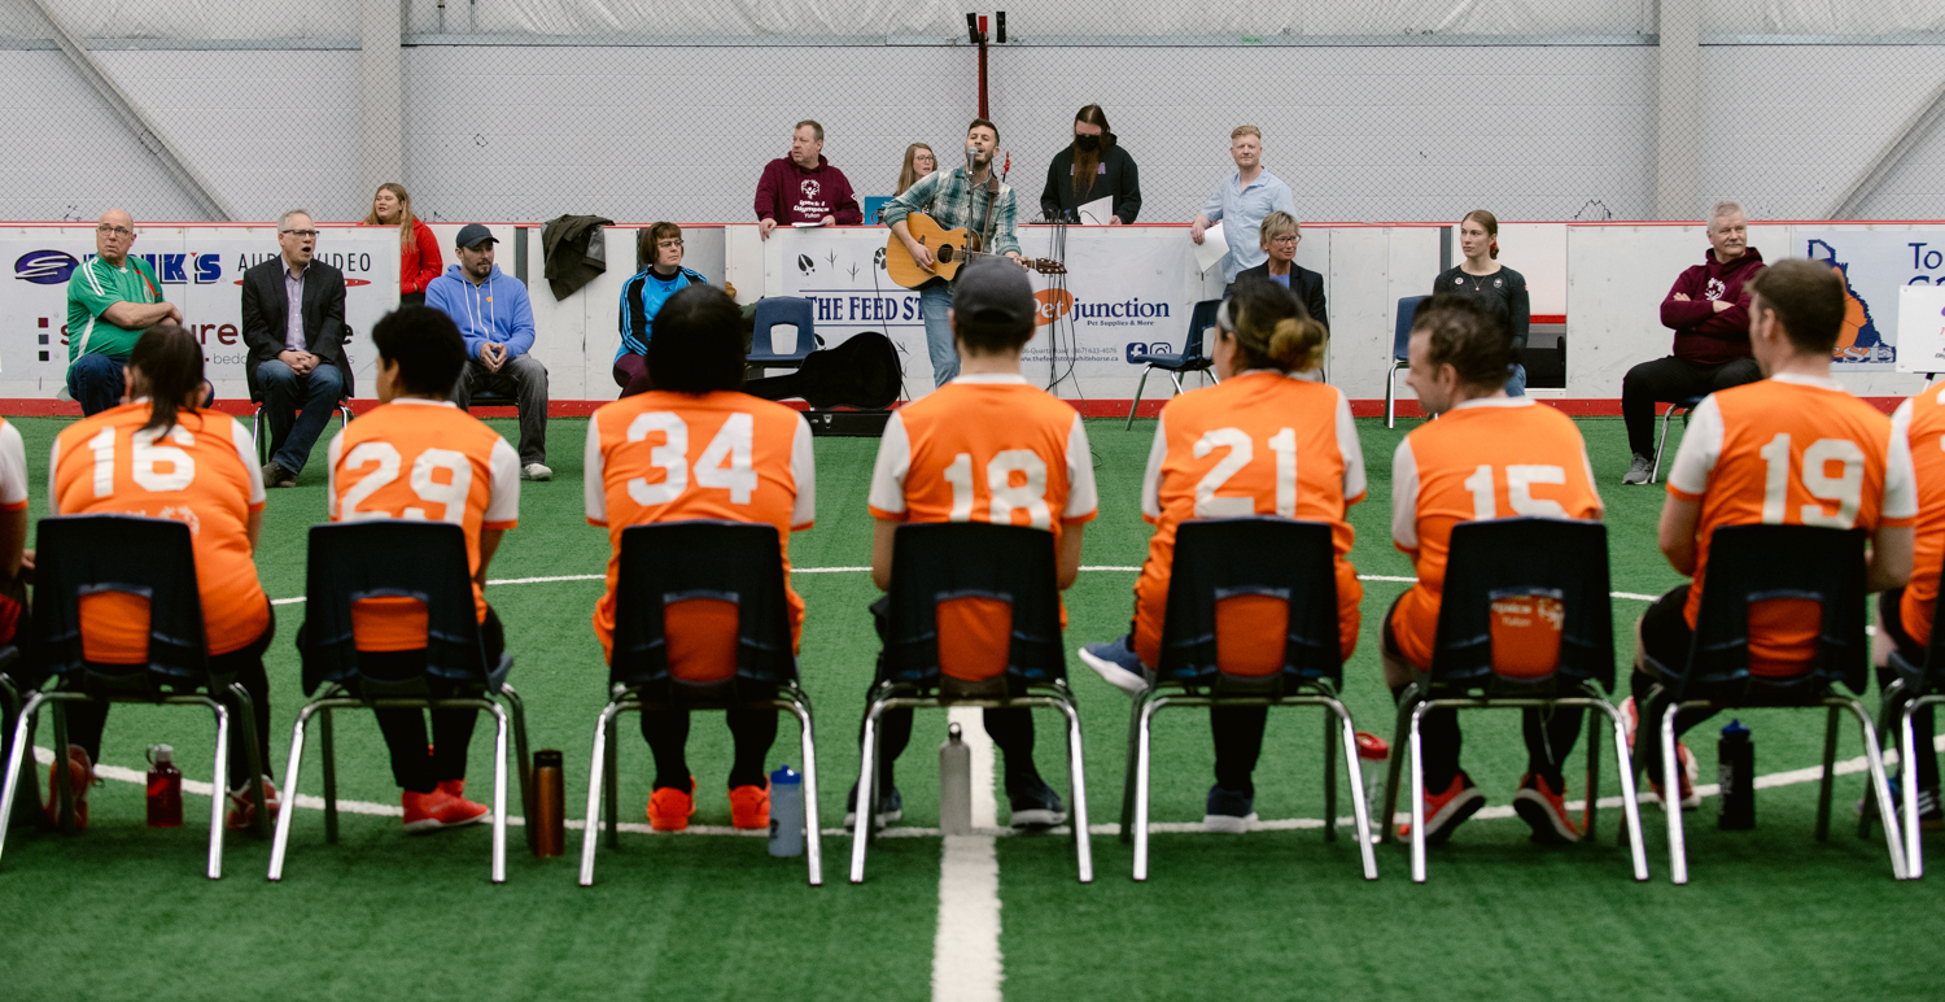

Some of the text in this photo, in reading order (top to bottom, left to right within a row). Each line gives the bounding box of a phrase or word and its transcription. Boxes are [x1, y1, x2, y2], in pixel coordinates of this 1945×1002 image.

[1907, 242, 1943, 270] To
[848, 296, 898, 321] FEED
[1073, 297, 1170, 322] junction
[88, 424, 196, 498] 16
[339, 442, 472, 523] 29
[626, 411, 758, 507] 34
[943, 449, 1052, 530] 18
[1193, 427, 1297, 518] 21
[1465, 464, 1568, 520] 15
[1760, 432, 1866, 530] 19
